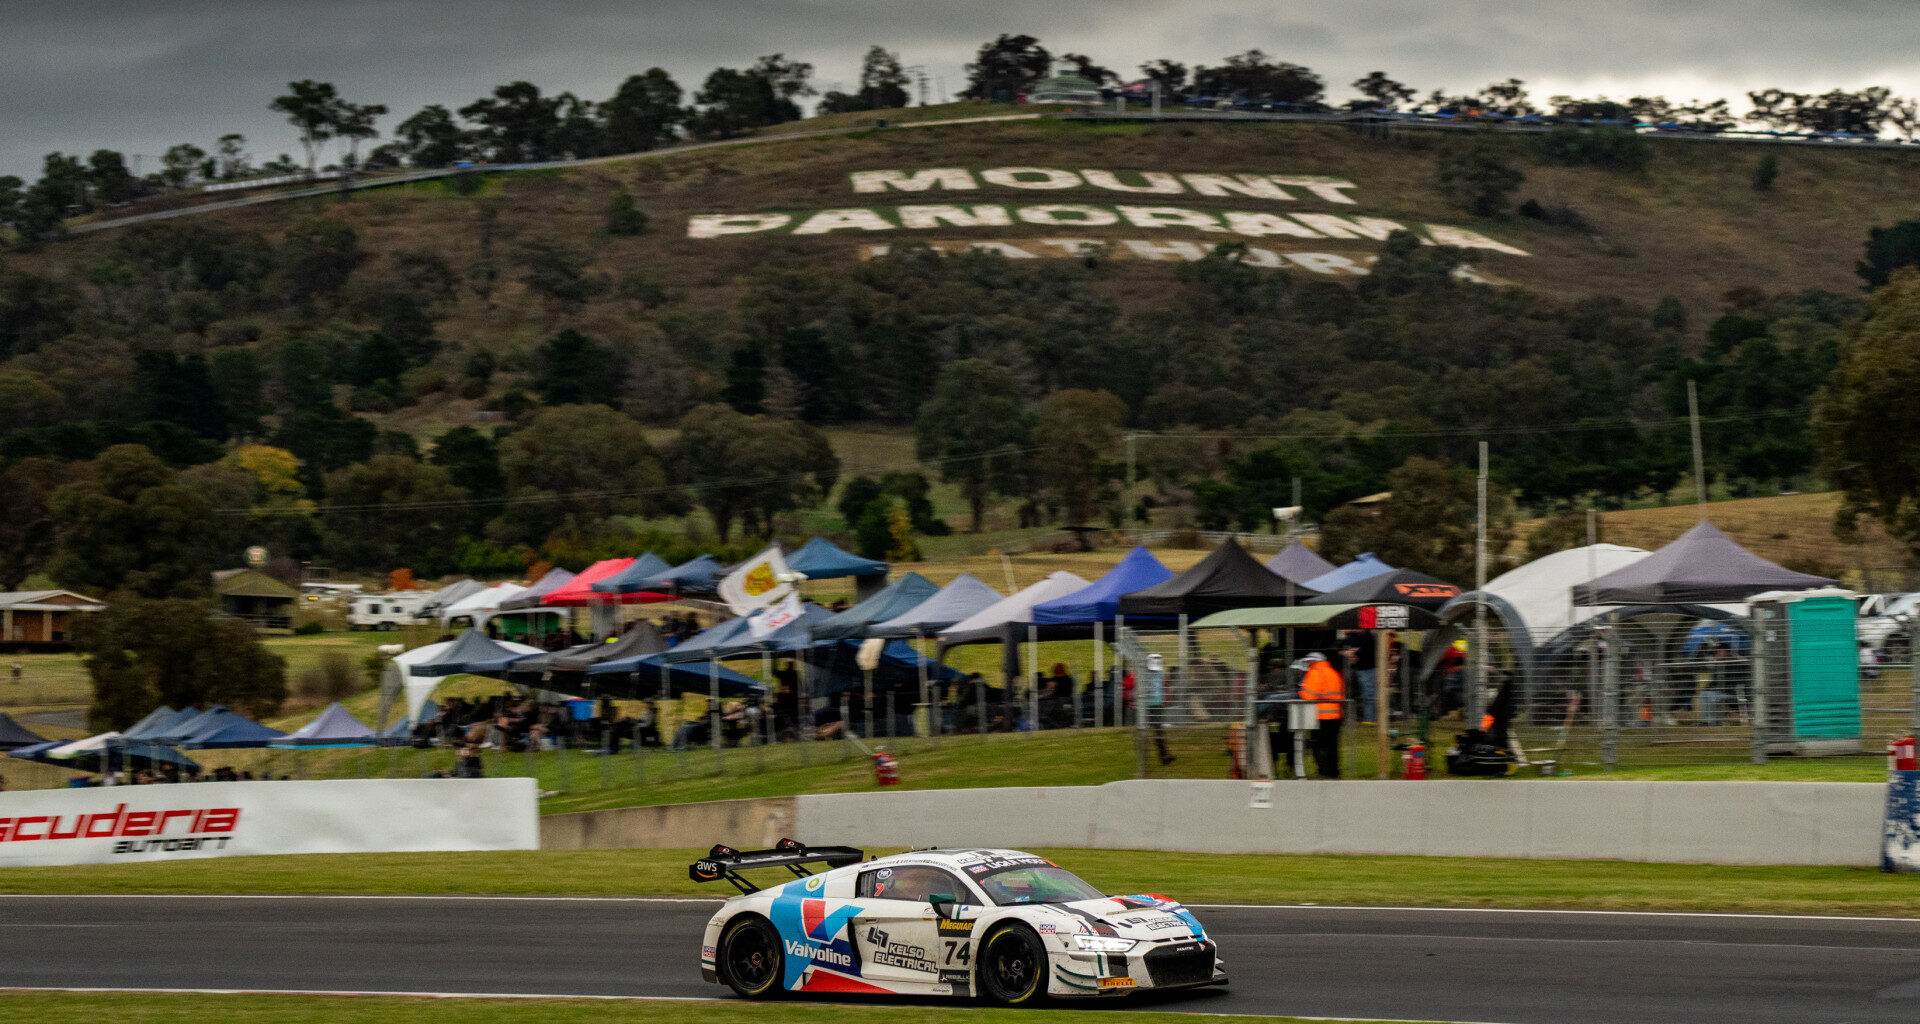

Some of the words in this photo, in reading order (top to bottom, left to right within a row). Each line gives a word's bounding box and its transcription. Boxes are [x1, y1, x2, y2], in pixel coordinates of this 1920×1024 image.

[850, 167, 1357, 205] MOUNT
[687, 203, 1532, 256] PANORAMA
[697, 861, 718, 872] aws
[940, 919, 974, 930] MEGUIAR'
[785, 939, 851, 967] Valvoline
[875, 951, 938, 973] ELECTRICAL
[888, 943, 925, 959] KELSO
[945, 941, 970, 965] 74
[1103, 978, 1133, 986] PIRELLI
